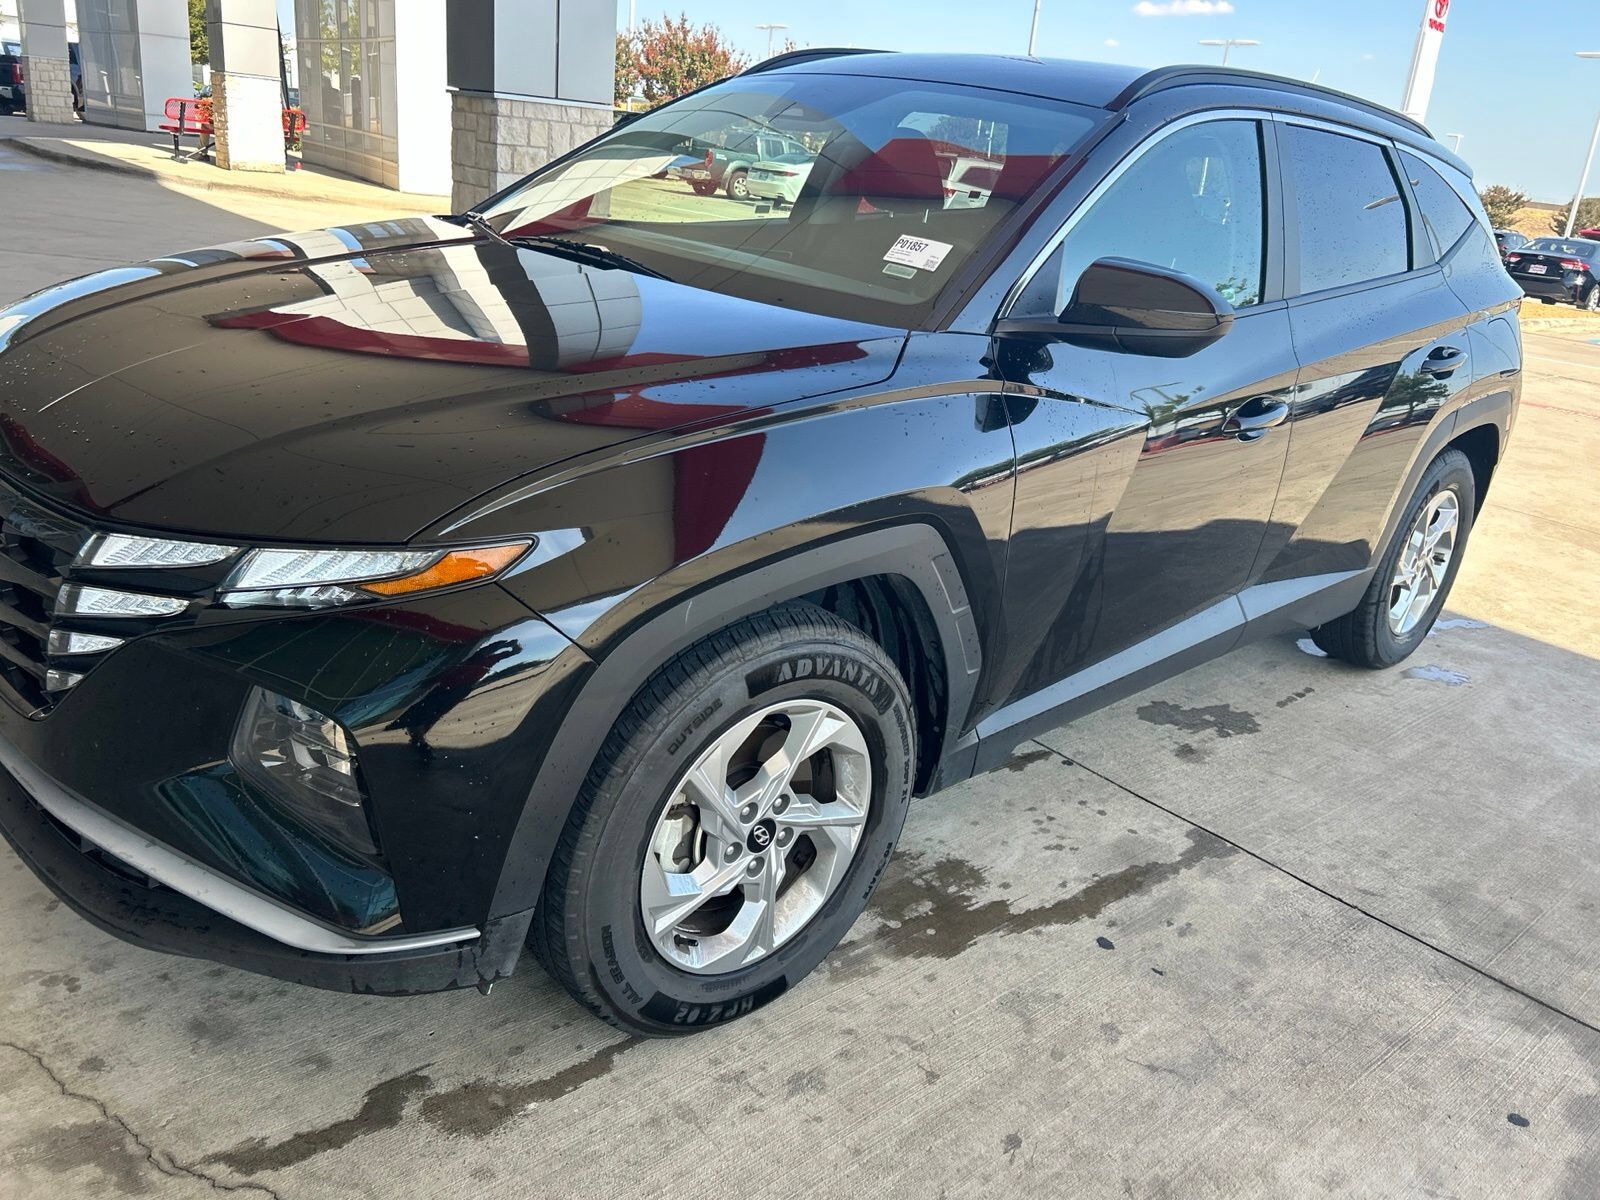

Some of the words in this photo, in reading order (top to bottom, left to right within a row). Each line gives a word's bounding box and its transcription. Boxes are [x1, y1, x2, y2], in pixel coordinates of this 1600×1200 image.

[895, 239, 928, 252] P01857
[777, 658, 880, 694] ADVANTA
[667, 698, 722, 755] OUTSIDE
[600, 925, 626, 985] SEASON
[622, 981, 643, 1004] ALL
